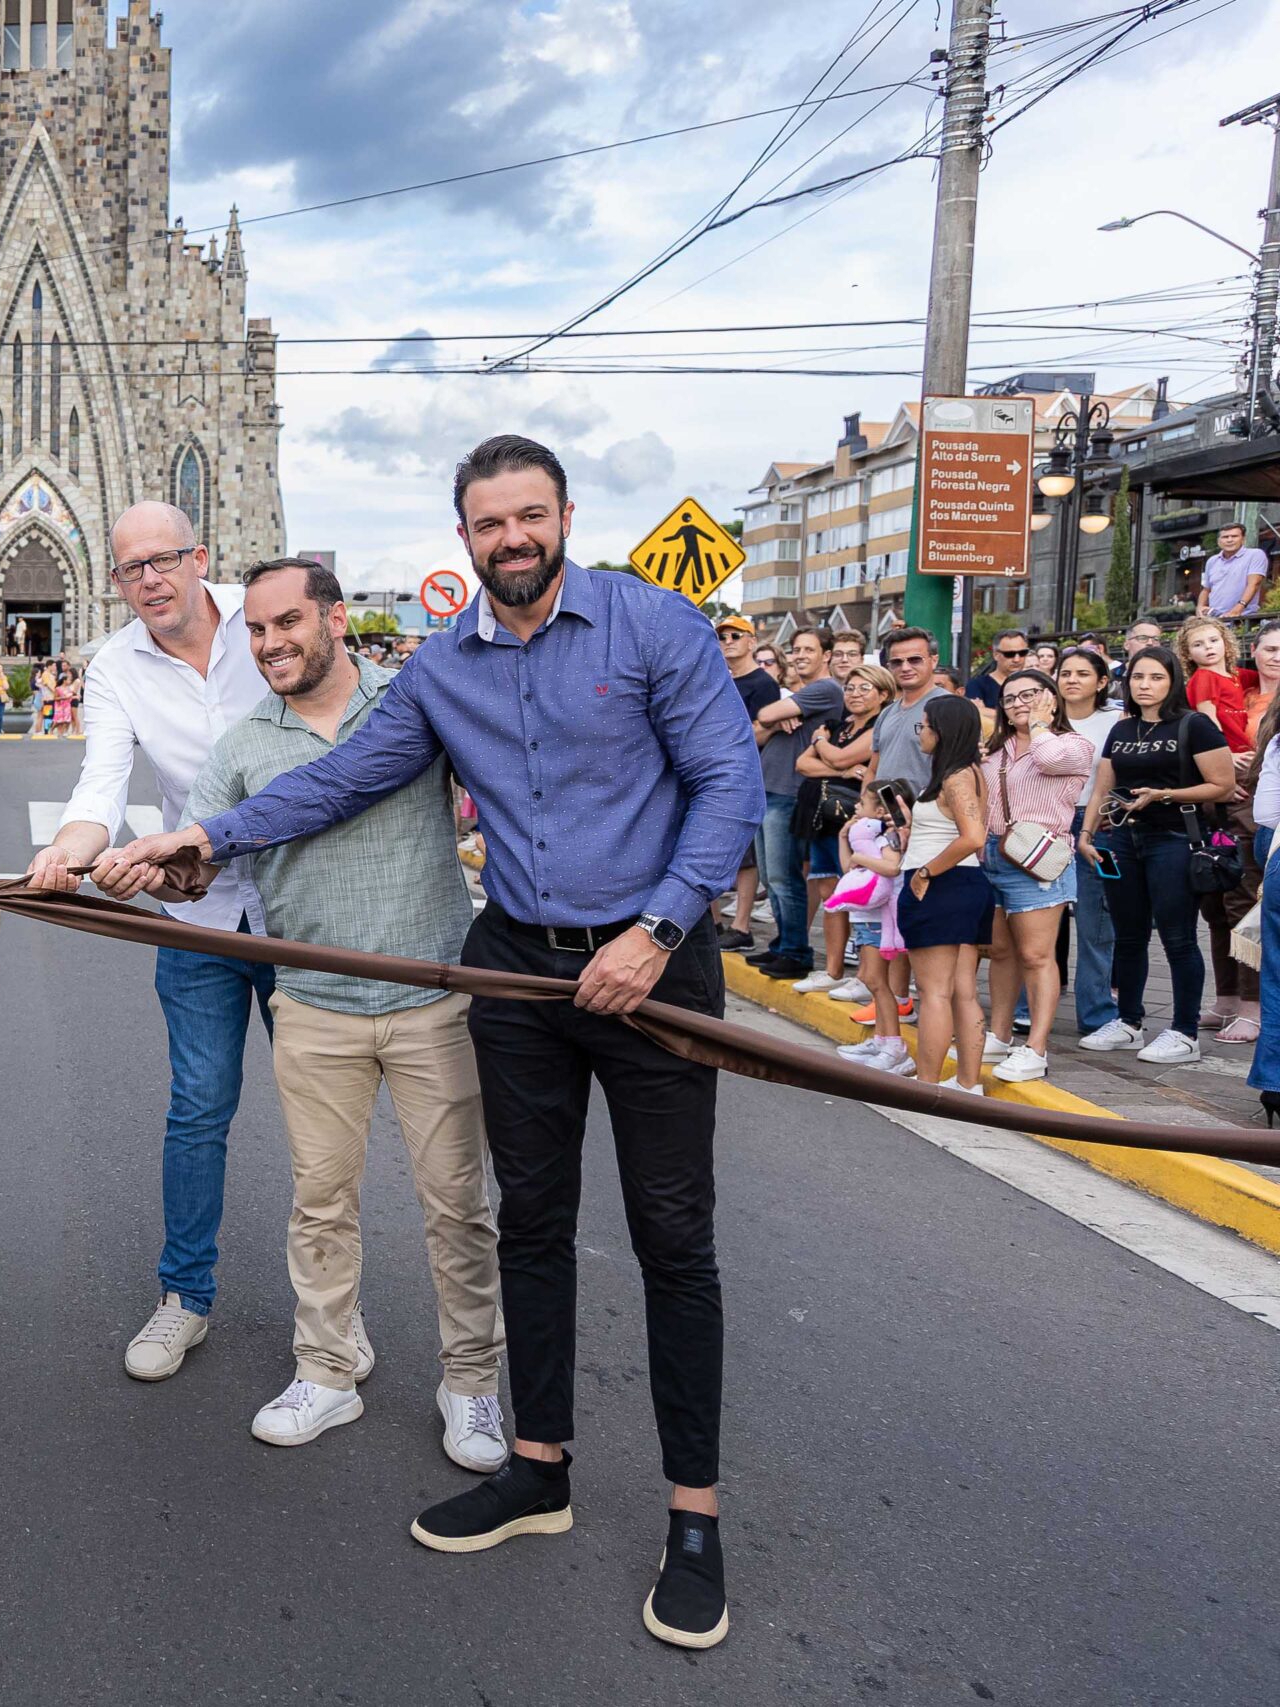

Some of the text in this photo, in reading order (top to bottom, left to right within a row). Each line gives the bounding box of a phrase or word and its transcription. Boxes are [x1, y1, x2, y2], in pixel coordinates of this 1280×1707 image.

[931, 439, 979, 451] Pousada
[931, 451, 1001, 463] Alto da Serra
[931, 468, 978, 479] Pousada
[930, 479, 1011, 493] Floresta Negra
[930, 499, 1015, 512] Pousada Quinta
[929, 510, 998, 523] dos Marques
[928, 540, 976, 551] Pousada
[928, 551, 995, 565] Blumenberg
[1111, 740, 1177, 754] GUESS
